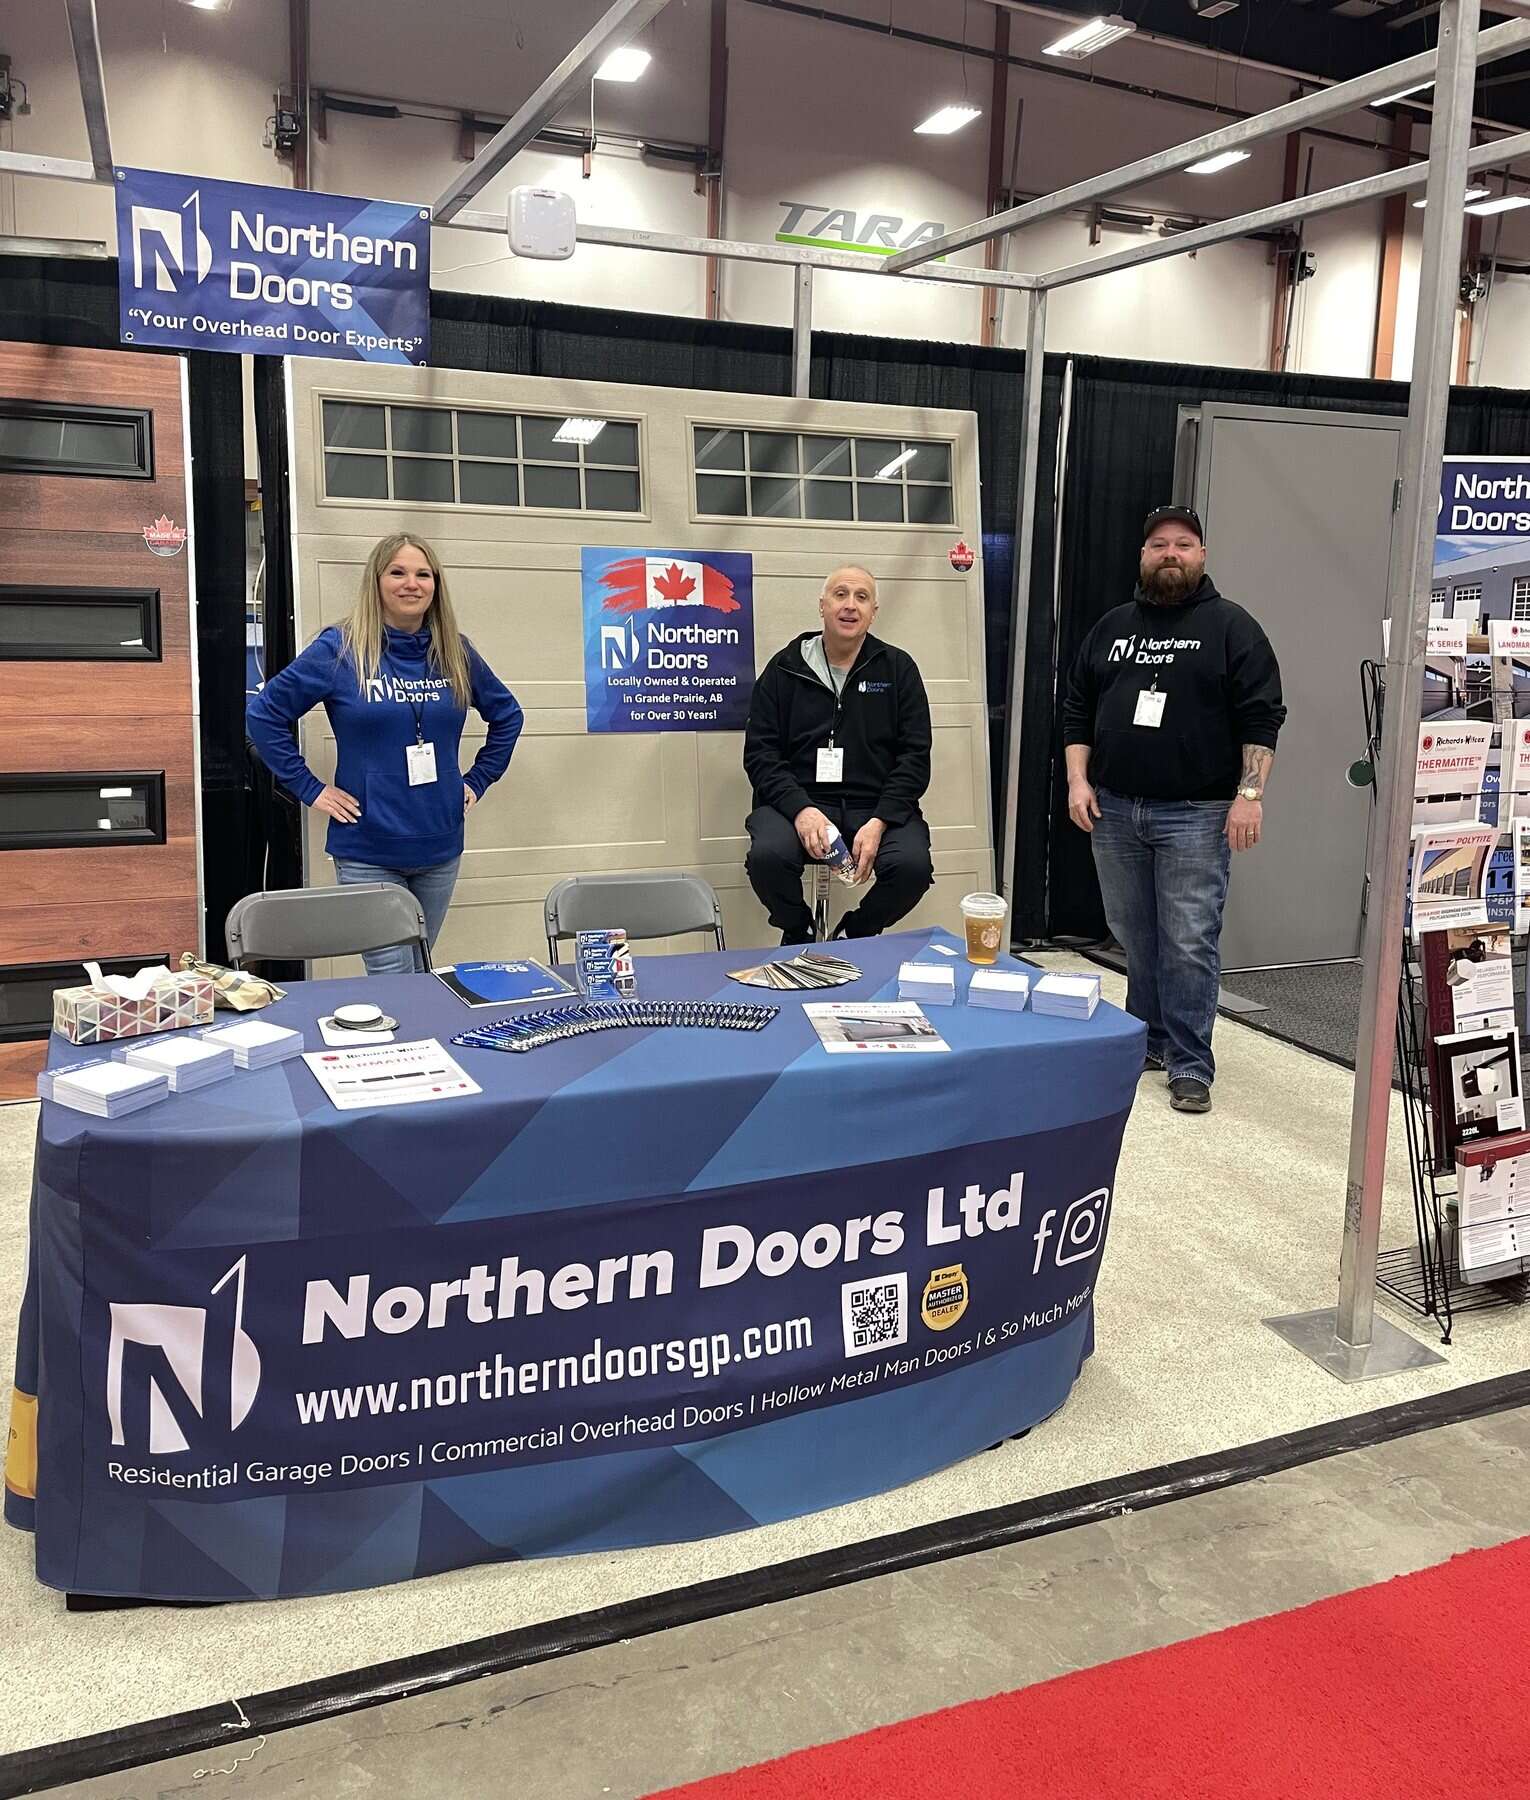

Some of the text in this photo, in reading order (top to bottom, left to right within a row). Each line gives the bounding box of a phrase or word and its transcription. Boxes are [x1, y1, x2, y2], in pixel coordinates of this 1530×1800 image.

[778, 201, 945, 248] TARA
[230, 209, 417, 271] Northern
[229, 261, 353, 310] Doors
[192, 316, 288, 339] Overhead
[293, 324, 340, 345] Door
[647, 622, 739, 644] Northern
[1139, 637, 1201, 651] Northern
[1437, 640, 1463, 648] SERIES
[647, 648, 709, 670] Doors
[1135, 651, 1175, 664] Doors
[607, 675, 737, 688] Locally Owned & Operated
[623, 692, 723, 705] in Grande Prairie, AB
[630, 710, 717, 720] for Over 30 Years!
[302, 1172, 1024, 1345] Northern Doors Ltd
[927, 1294, 963, 1308] AUTHORIZED
[928, 1285, 962, 1301] MASTER
[931, 1304, 959, 1318] DEALER
[295, 1316, 813, 1425] www.northerndoorsgp.com
[108, 1462, 238, 1489] Residential
[246, 1461, 332, 1484] Garage
[341, 1451, 410, 1475] Doors
[431, 1425, 563, 1463] Commercial
[570, 1408, 675, 1442] Overhead
[683, 1402, 743, 1428] Doors
[761, 1383, 826, 1411] Hollow
[830, 1365, 879, 1393] Metal
[884, 1357, 919, 1379] Man
[924, 1339, 971, 1367] Doors
[984, 1328, 996, 1345] &
[1000, 1322, 1019, 1340] So
[1022, 1304, 1062, 1331] Much
[1065, 1286, 1091, 1315] More
